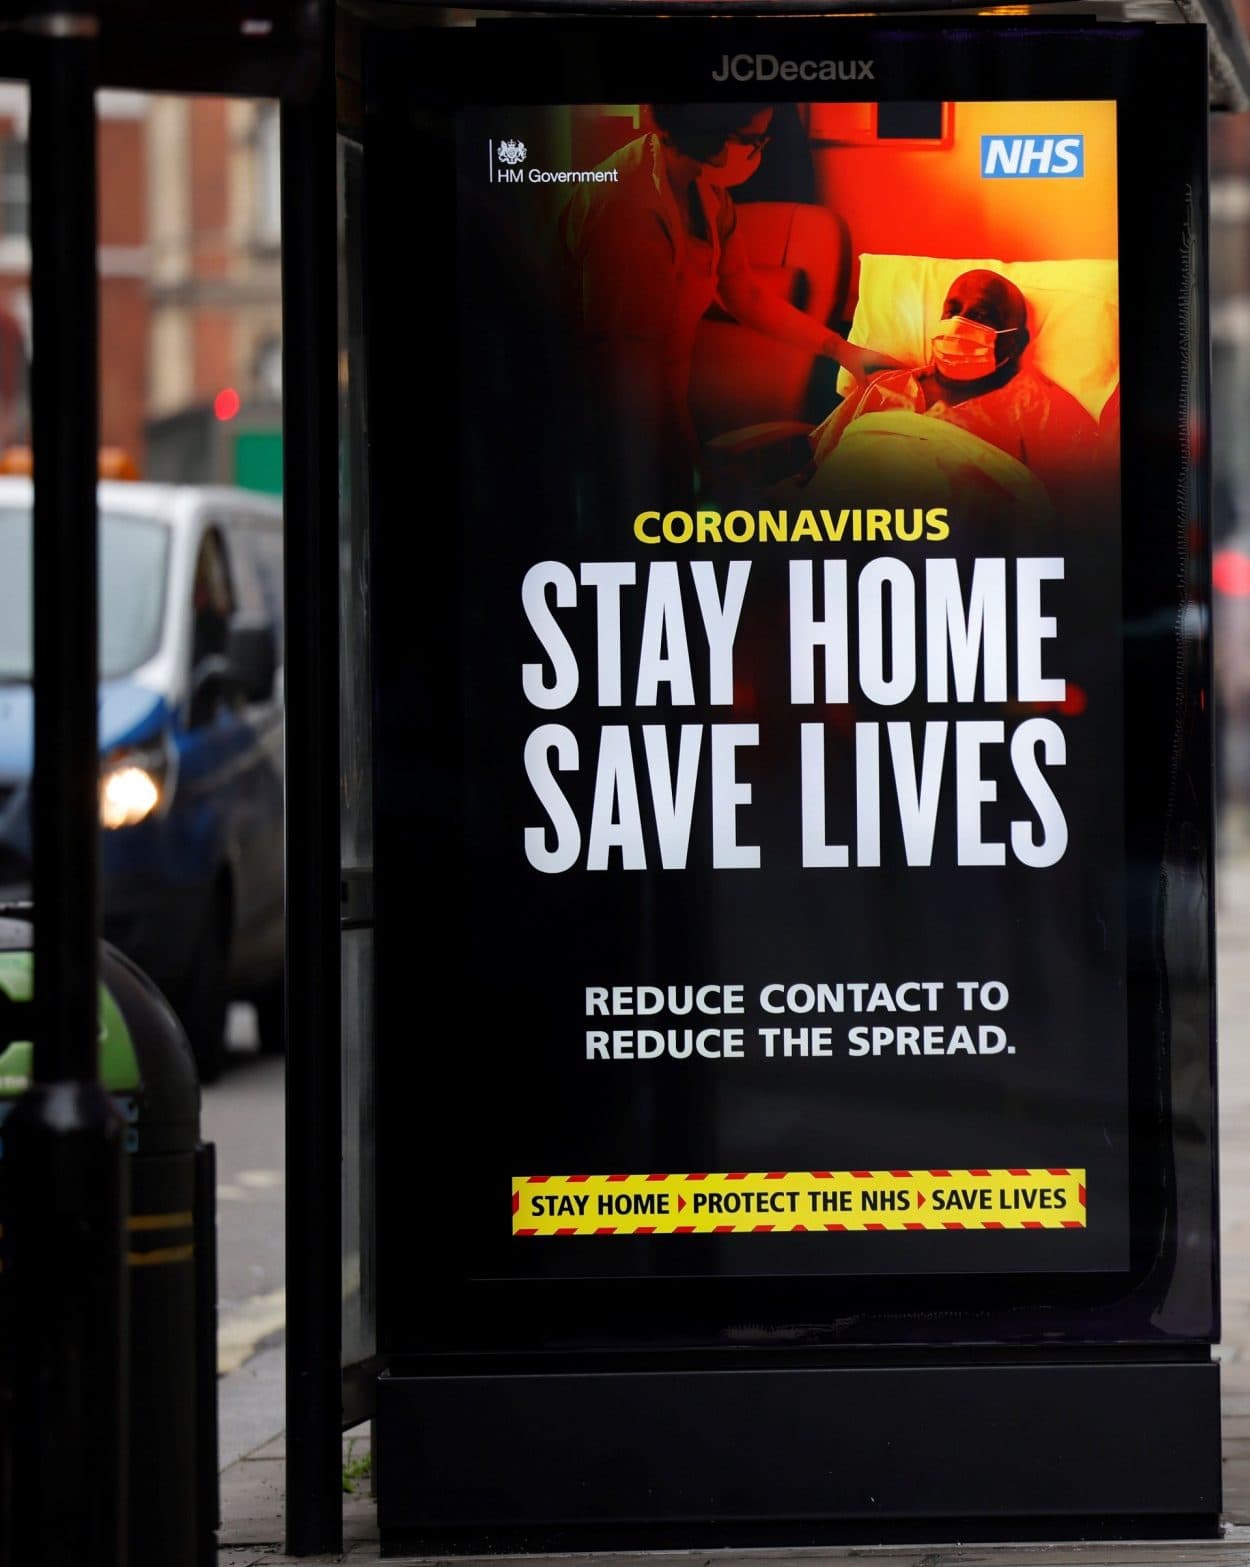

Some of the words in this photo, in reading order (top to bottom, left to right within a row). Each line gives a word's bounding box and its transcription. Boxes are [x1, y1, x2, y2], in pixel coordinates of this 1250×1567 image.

[712, 55, 875, 82] JCDecaux
[984, 139, 1080, 174] NHS
[497, 169, 524, 182] HM
[528, 168, 618, 182] Government
[633, 508, 950, 544] CORONAVIRUS
[521, 560, 753, 710] STAY
[788, 556, 1067, 706] HOME
[523, 723, 761, 874] SAVE
[800, 717, 1069, 868] LIVES
[585, 984, 745, 1016] REDUCE
[759, 982, 944, 1014] CONTACT
[956, 980, 1009, 1012] TO
[585, 1028, 745, 1060] REDUCE
[758, 1027, 833, 1058] THE
[847, 1025, 1016, 1057] SPREAD.
[531, 1194, 590, 1217] STAY
[598, 1193, 670, 1216] HOME
[693, 1191, 800, 1215] PROTECT
[807, 1191, 852, 1213] THE
[861, 1190, 910, 1213] NHS
[932, 1189, 993, 1212] SAVE
[999, 1188, 1067, 1211] LIVES
